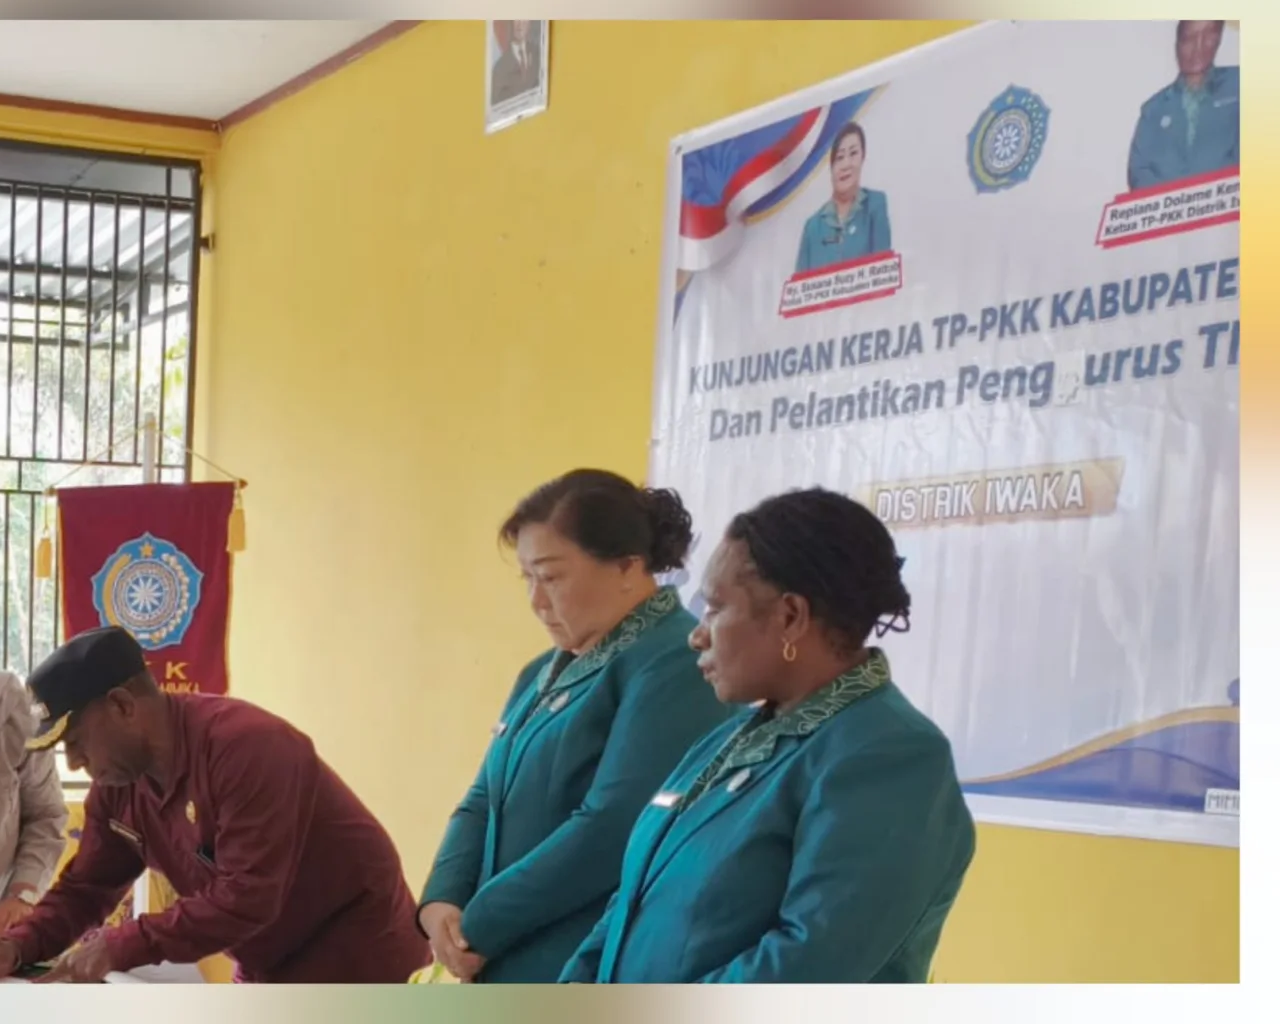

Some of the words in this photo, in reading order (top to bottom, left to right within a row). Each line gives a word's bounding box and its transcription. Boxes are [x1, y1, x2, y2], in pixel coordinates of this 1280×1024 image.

[689, 339, 835, 395] KUNJUNGAN
[840, 322, 923, 368] KERJA
[932, 297, 1043, 351] TP-PKK
[1049, 257, 1239, 328] KABUPATE
[709, 408, 763, 442] Dan
[769, 378, 945, 435] Pelantikan
[877, 480, 980, 524] DISTRIK
[984, 470, 1086, 515] IWAKA
